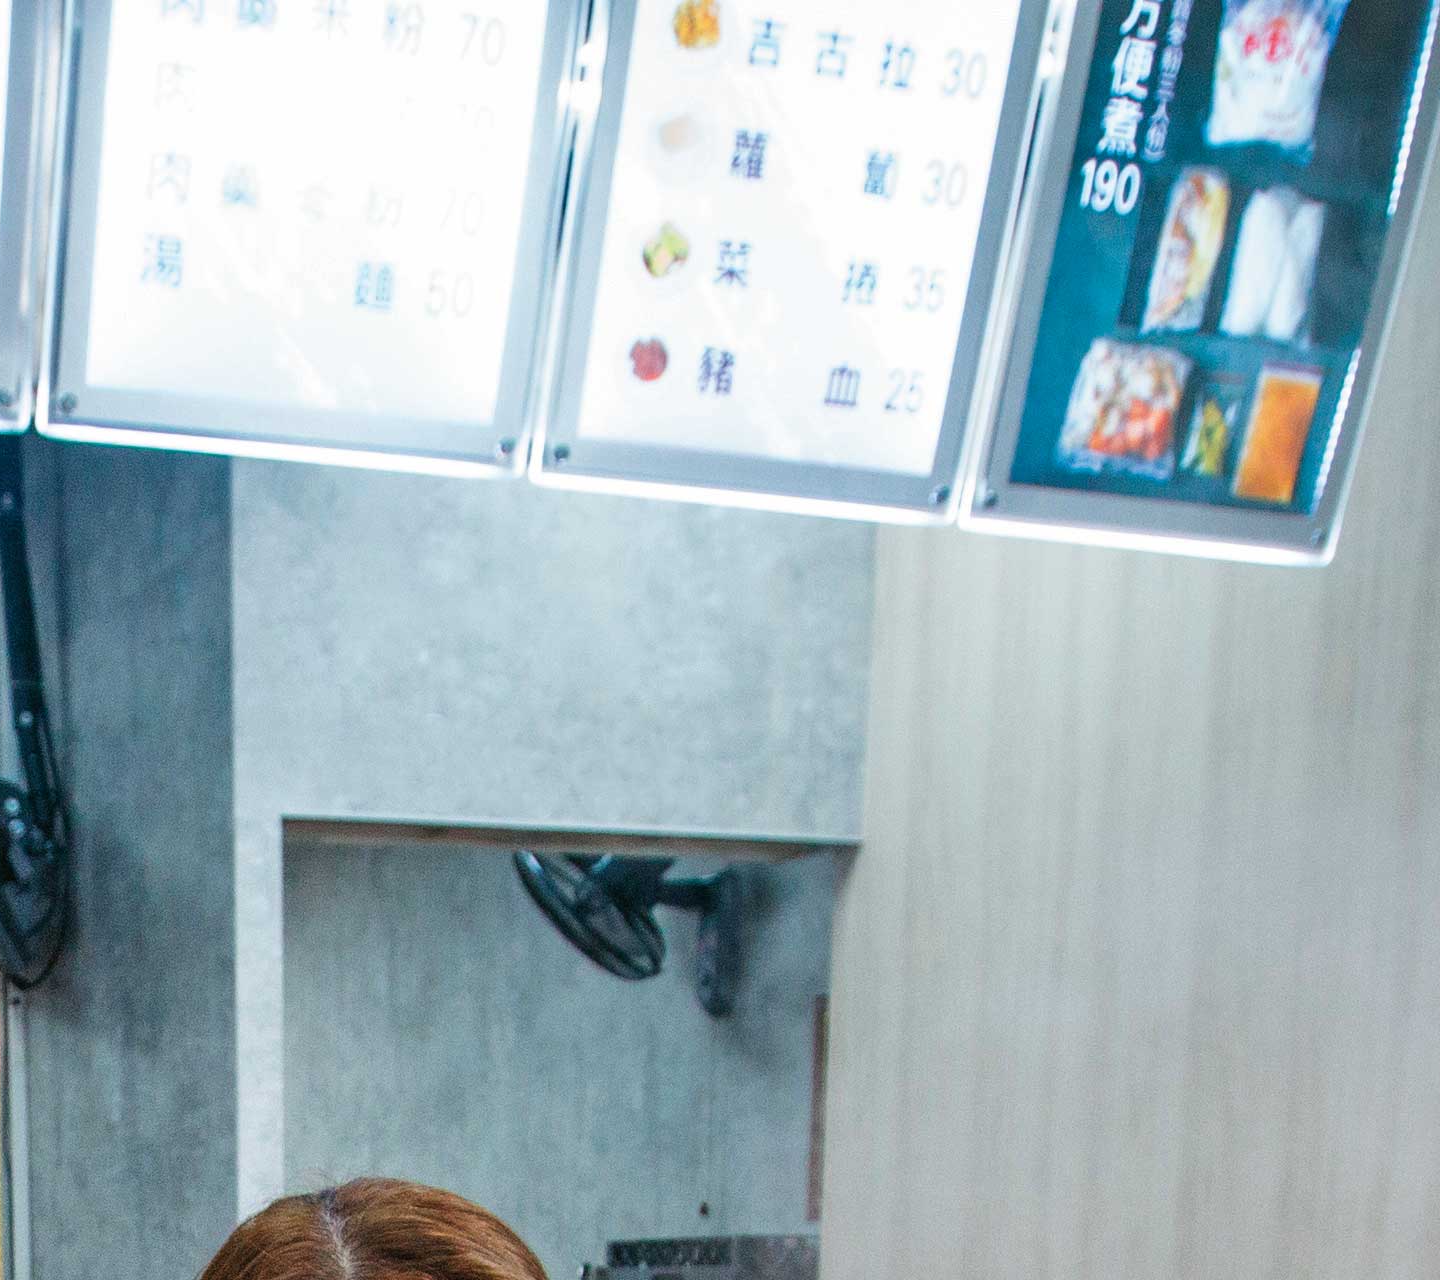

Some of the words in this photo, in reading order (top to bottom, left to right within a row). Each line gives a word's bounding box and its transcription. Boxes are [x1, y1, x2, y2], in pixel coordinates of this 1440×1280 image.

[458, 13, 506, 66] 70
[941, 47, 987, 99] 30
[923, 158, 968, 208] 30
[1080, 159, 1142, 215] 190
[903, 266, 946, 313] 35
[885, 369, 925, 413] 25
